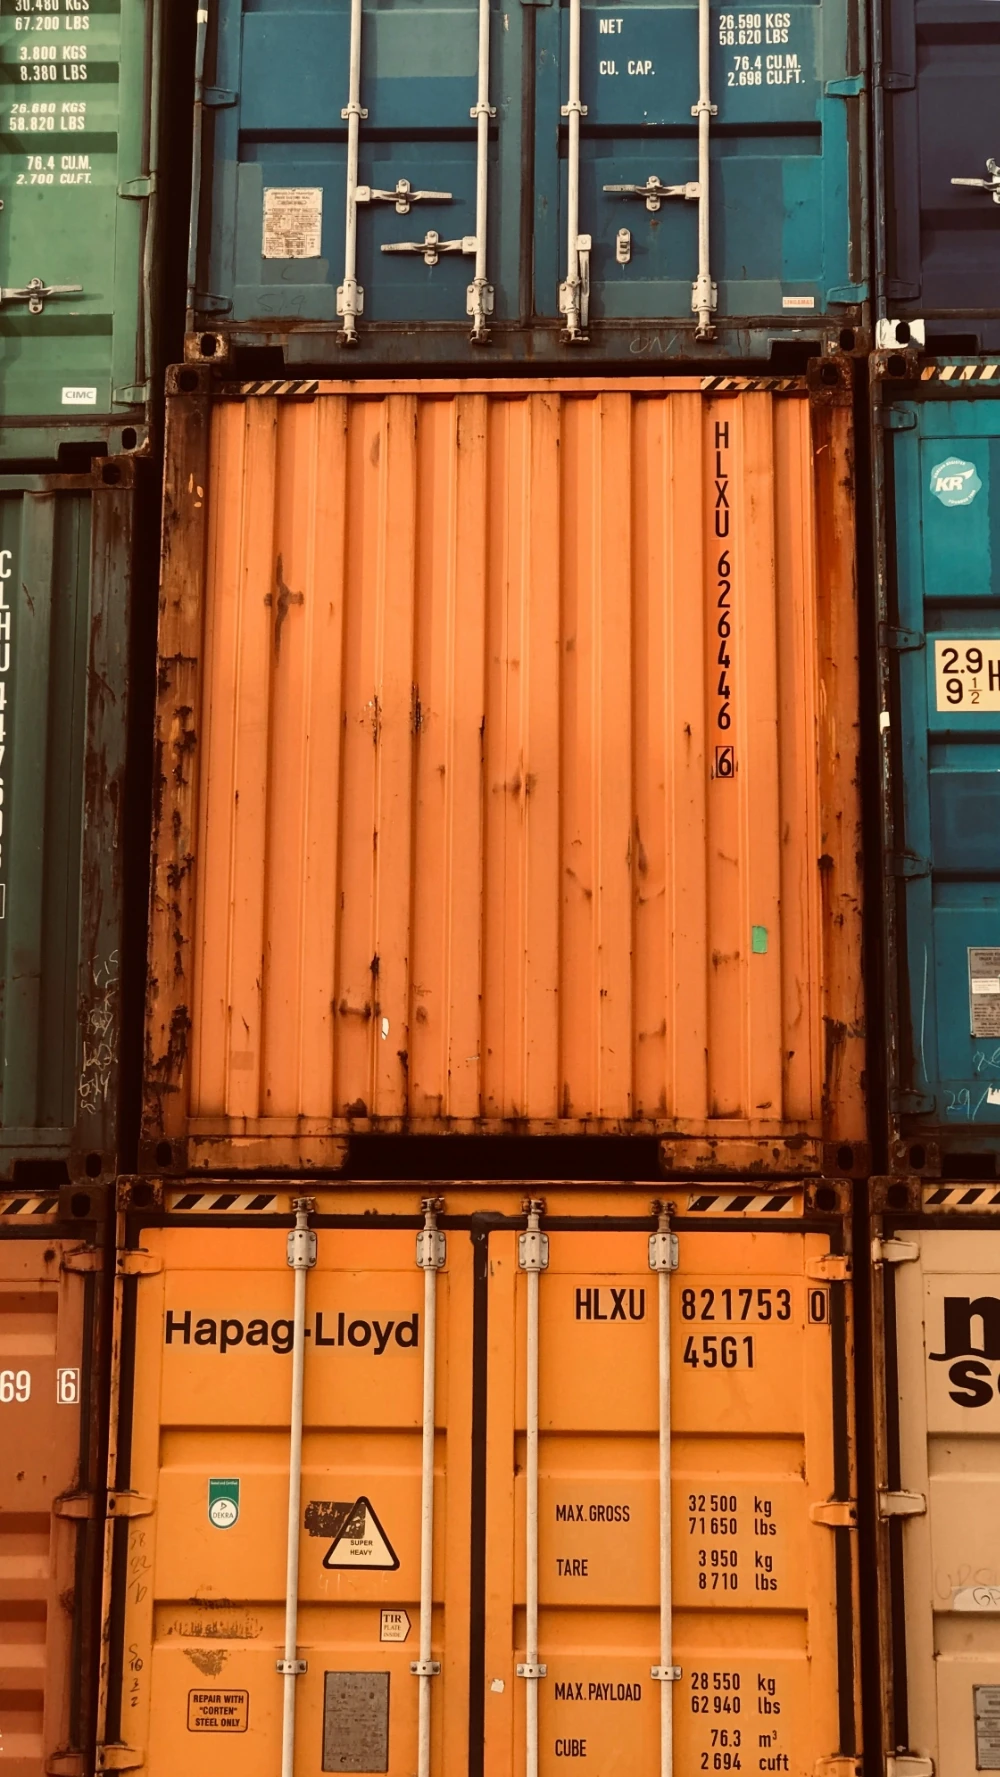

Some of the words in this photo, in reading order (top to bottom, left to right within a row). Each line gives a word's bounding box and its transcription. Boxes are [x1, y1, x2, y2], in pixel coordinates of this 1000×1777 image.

[65, 0, 90, 11] KGS
[15, 16, 60, 31] 67.200
[65, 15, 90, 30] LBS
[599, 19, 624, 34] NET
[719, 14, 762, 30] 26.590
[765, 13, 791, 29] KGS
[719, 30, 762, 46] 58.620
[766, 29, 789, 45] LBS
[20, 46, 57, 61] 3.800
[62, 45, 87, 60] KGS
[599, 60, 619, 75] CU.
[627, 60, 656, 76] CAP.
[733, 56, 762, 71] 76.4
[766, 54, 802, 70] CU.M.
[20, 65, 57, 81] 8.380
[63, 64, 88, 80] LBS
[727, 71, 762, 87] 2.698
[766, 70, 806, 85] CU.FT.
[10, 102, 56, 114] 26.680
[61, 102, 87, 113] KGS
[9, 116, 55, 131] 58.820
[60, 116, 85, 130] LBS
[26, 155, 55, 170] 76.4
[61, 155, 92, 170] CU.M.
[16, 173, 54, 185] 2.700
[60, 172, 92, 184] CU.FT.
[714, 421, 730, 537] HLXU
[935, 476, 964, 492] KR
[717, 550, 731, 730] 626446
[941, 647, 983, 674] 2.9
[717, 747, 733, 777] 6
[575, 1288, 645, 1320] HLXU
[681, 1288, 791, 1321] 821753
[165, 1310, 419, 1355] Hapag-Lloyd
[683, 1336, 754, 1368] 45G1
[60, 1370, 77, 1402] 6
[754, 1496, 772, 1517] kg
[754, 1519, 777, 1535] lbs
[556, 1559, 588, 1576] TARE
[755, 1551, 773, 1572] kg
[755, 1573, 778, 1591] lbs
[383, 1614, 401, 1623] TIR
[757, 1674, 776, 1696] kg
[193, 1694, 221, 1703] REPAIR
[224, 1695, 244, 1703] WITH
[758, 1697, 781, 1714] lbs
[199, 1706, 238, 1715] "CORTEN"
[195, 1718, 218, 1726] STEEL
[221, 1718, 240, 1727] ONLY
[710, 1729, 741, 1747] 76.3
[555, 1739, 587, 1757] CUBE
[758, 1753, 789, 1771] cuft
